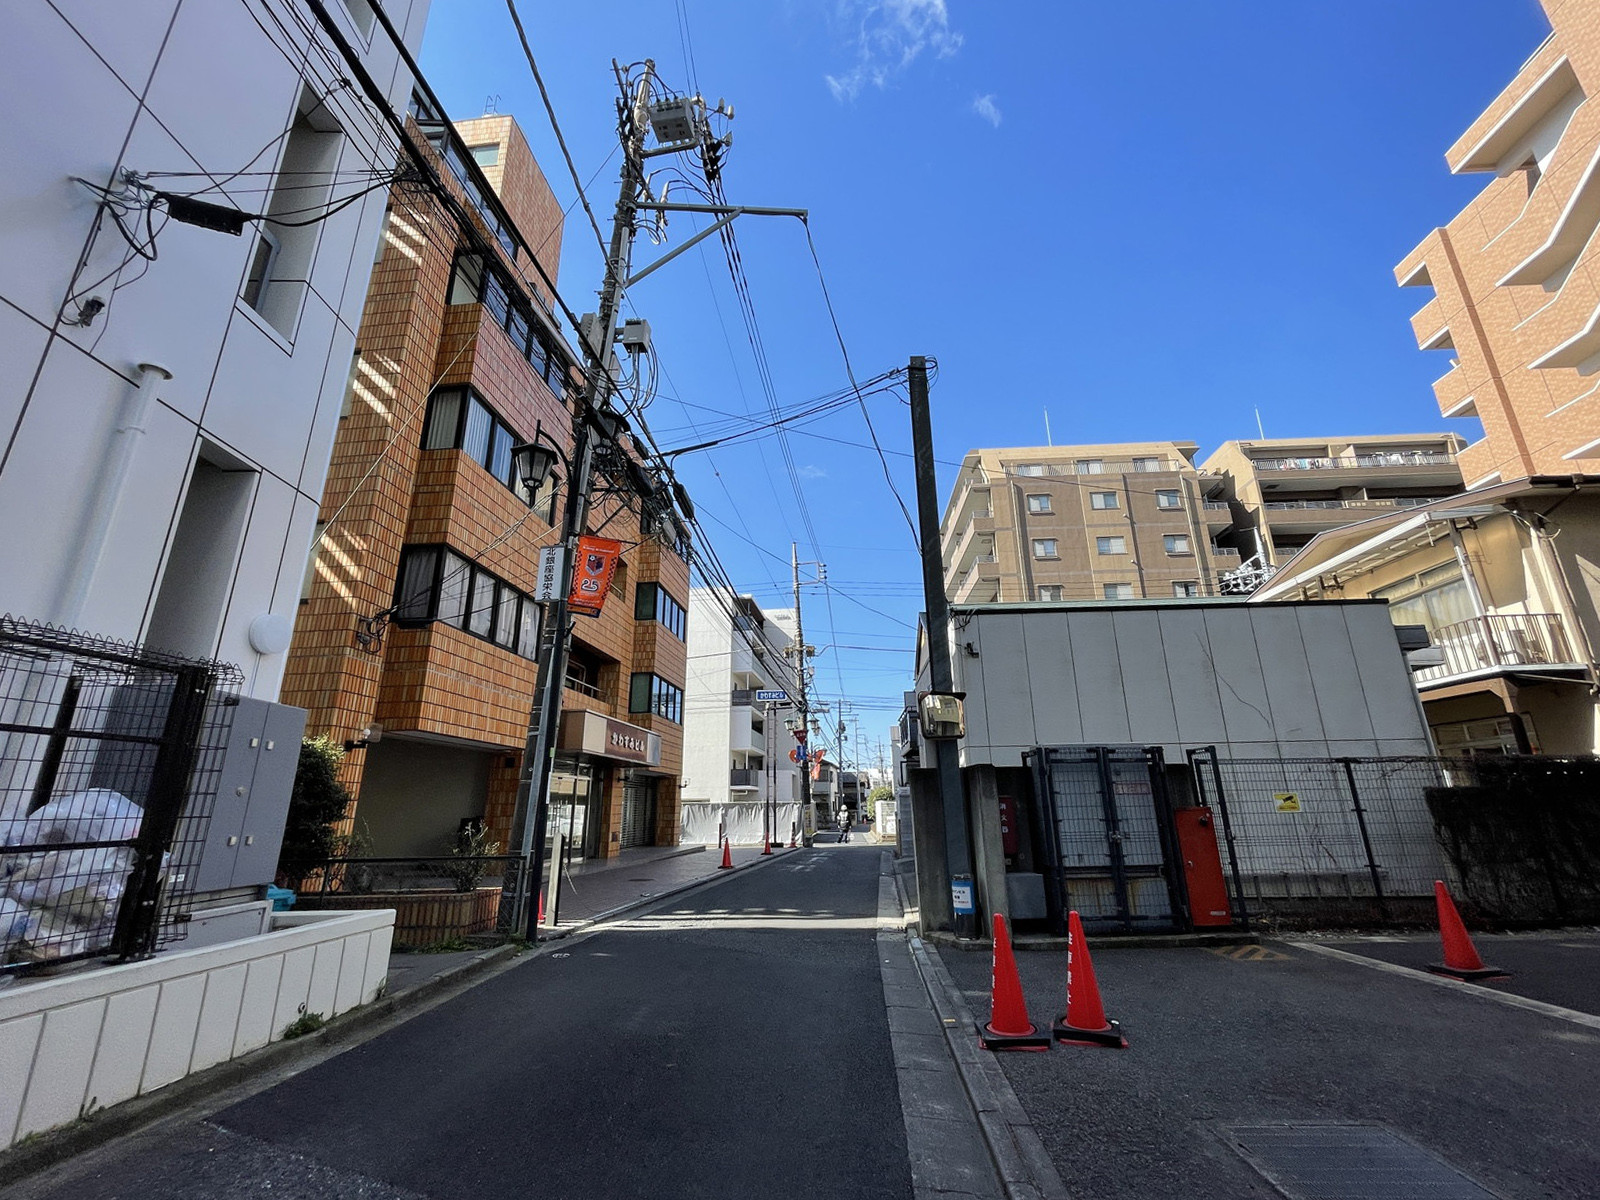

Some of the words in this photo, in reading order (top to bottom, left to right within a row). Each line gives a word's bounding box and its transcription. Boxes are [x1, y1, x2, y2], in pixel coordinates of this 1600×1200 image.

[541, 547, 556, 600] 北銀座協栄会
[611, 732, 645, 751] かわすみビル
